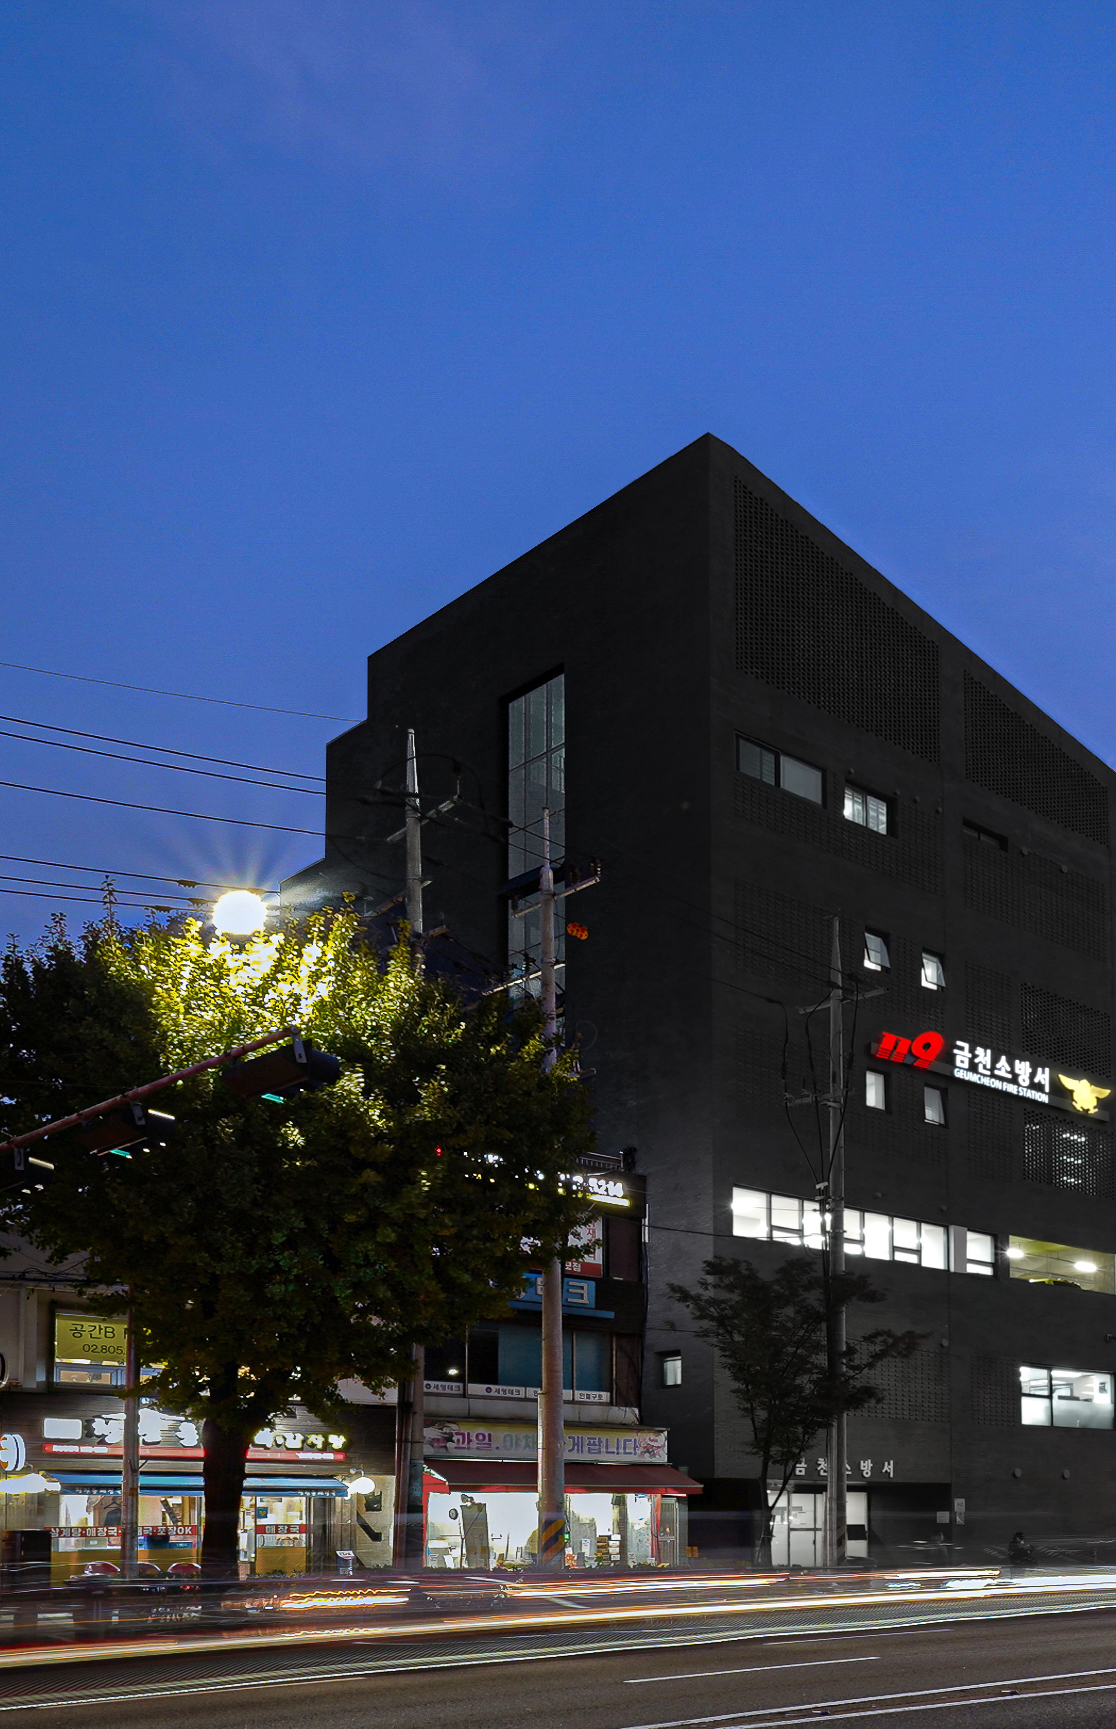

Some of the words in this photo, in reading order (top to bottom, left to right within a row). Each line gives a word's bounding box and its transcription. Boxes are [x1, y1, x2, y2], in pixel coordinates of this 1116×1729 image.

[876, 1031, 943, 1068] 119
[953, 1040, 1050, 1093] 금천소방서
[954, 1067, 1002, 1090] GEUMCHEON
[1002, 1081, 1018, 1095] FIRE
[1018, 1086, 1049, 1104] STATION
[69, 1323, 116, 1339] 공간B
[563, 1435, 638, 1456] 게팝니다
